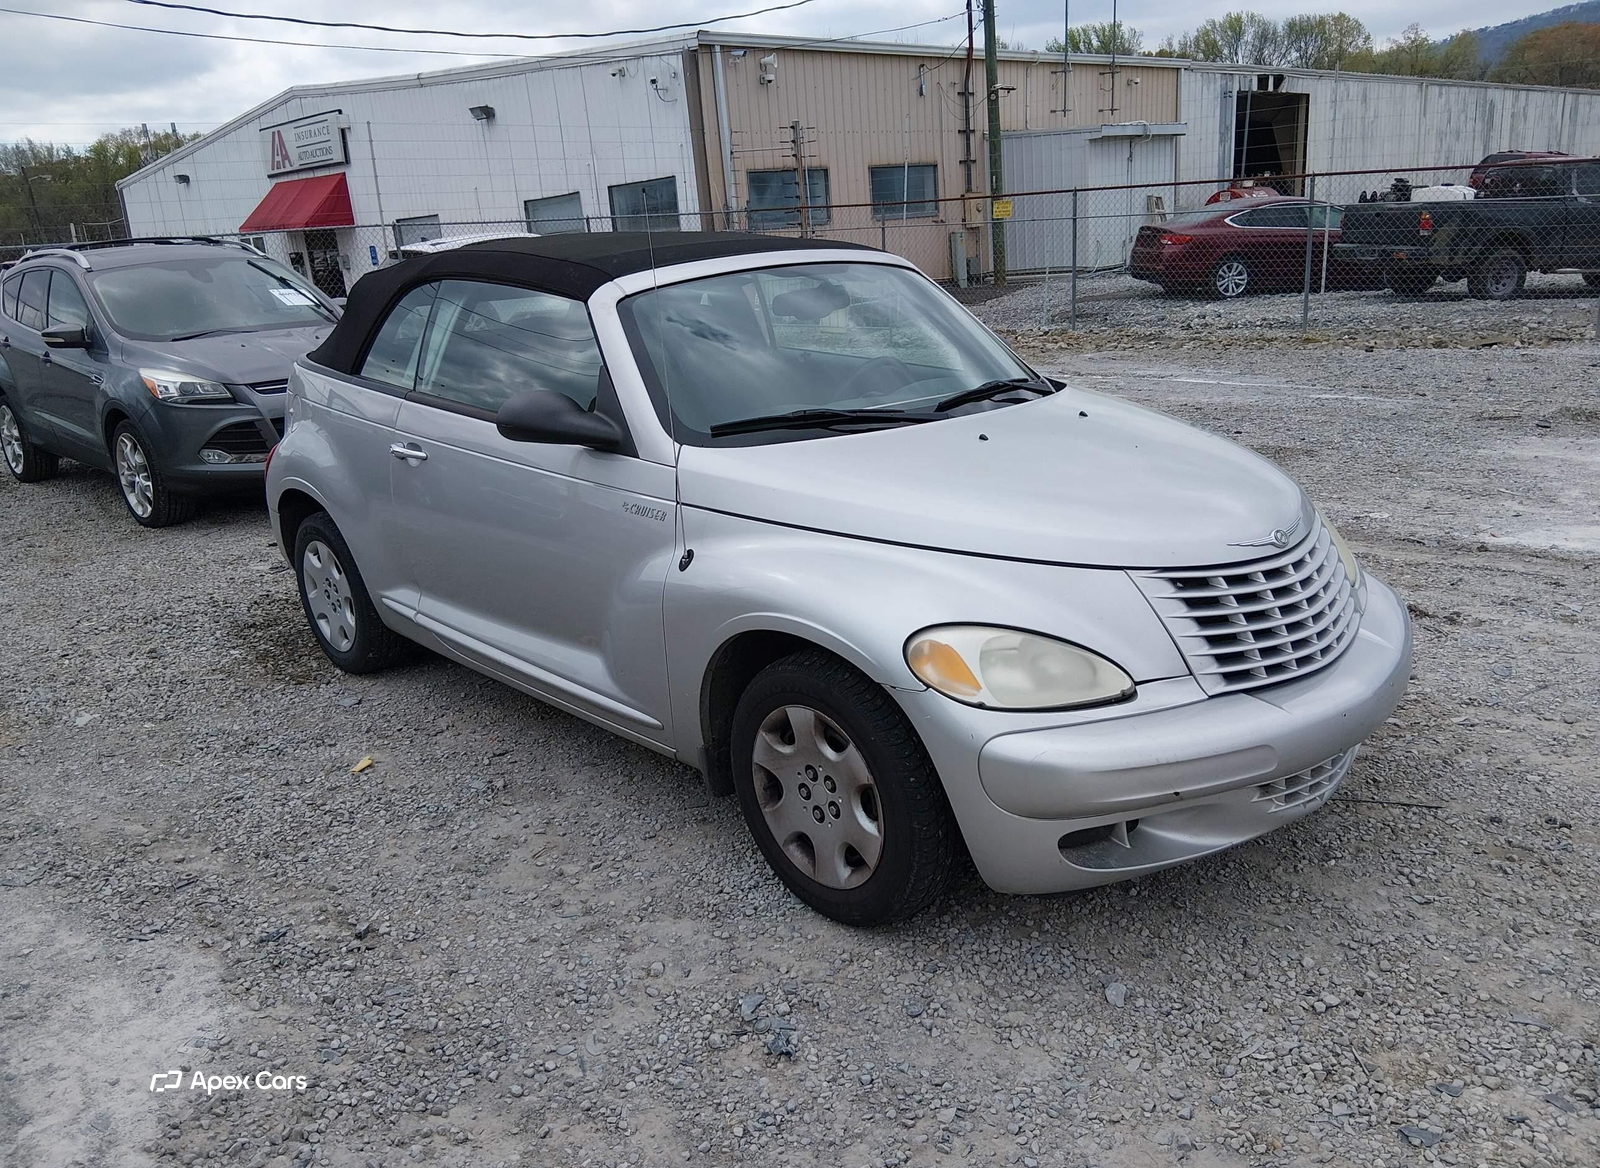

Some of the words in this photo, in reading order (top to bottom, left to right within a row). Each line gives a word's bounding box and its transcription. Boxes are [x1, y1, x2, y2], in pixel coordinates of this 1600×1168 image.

[294, 125, 331, 142] INSURANCE
[309, 145, 334, 159] AUCTIONS
[629, 503, 668, 522] CRUISER
